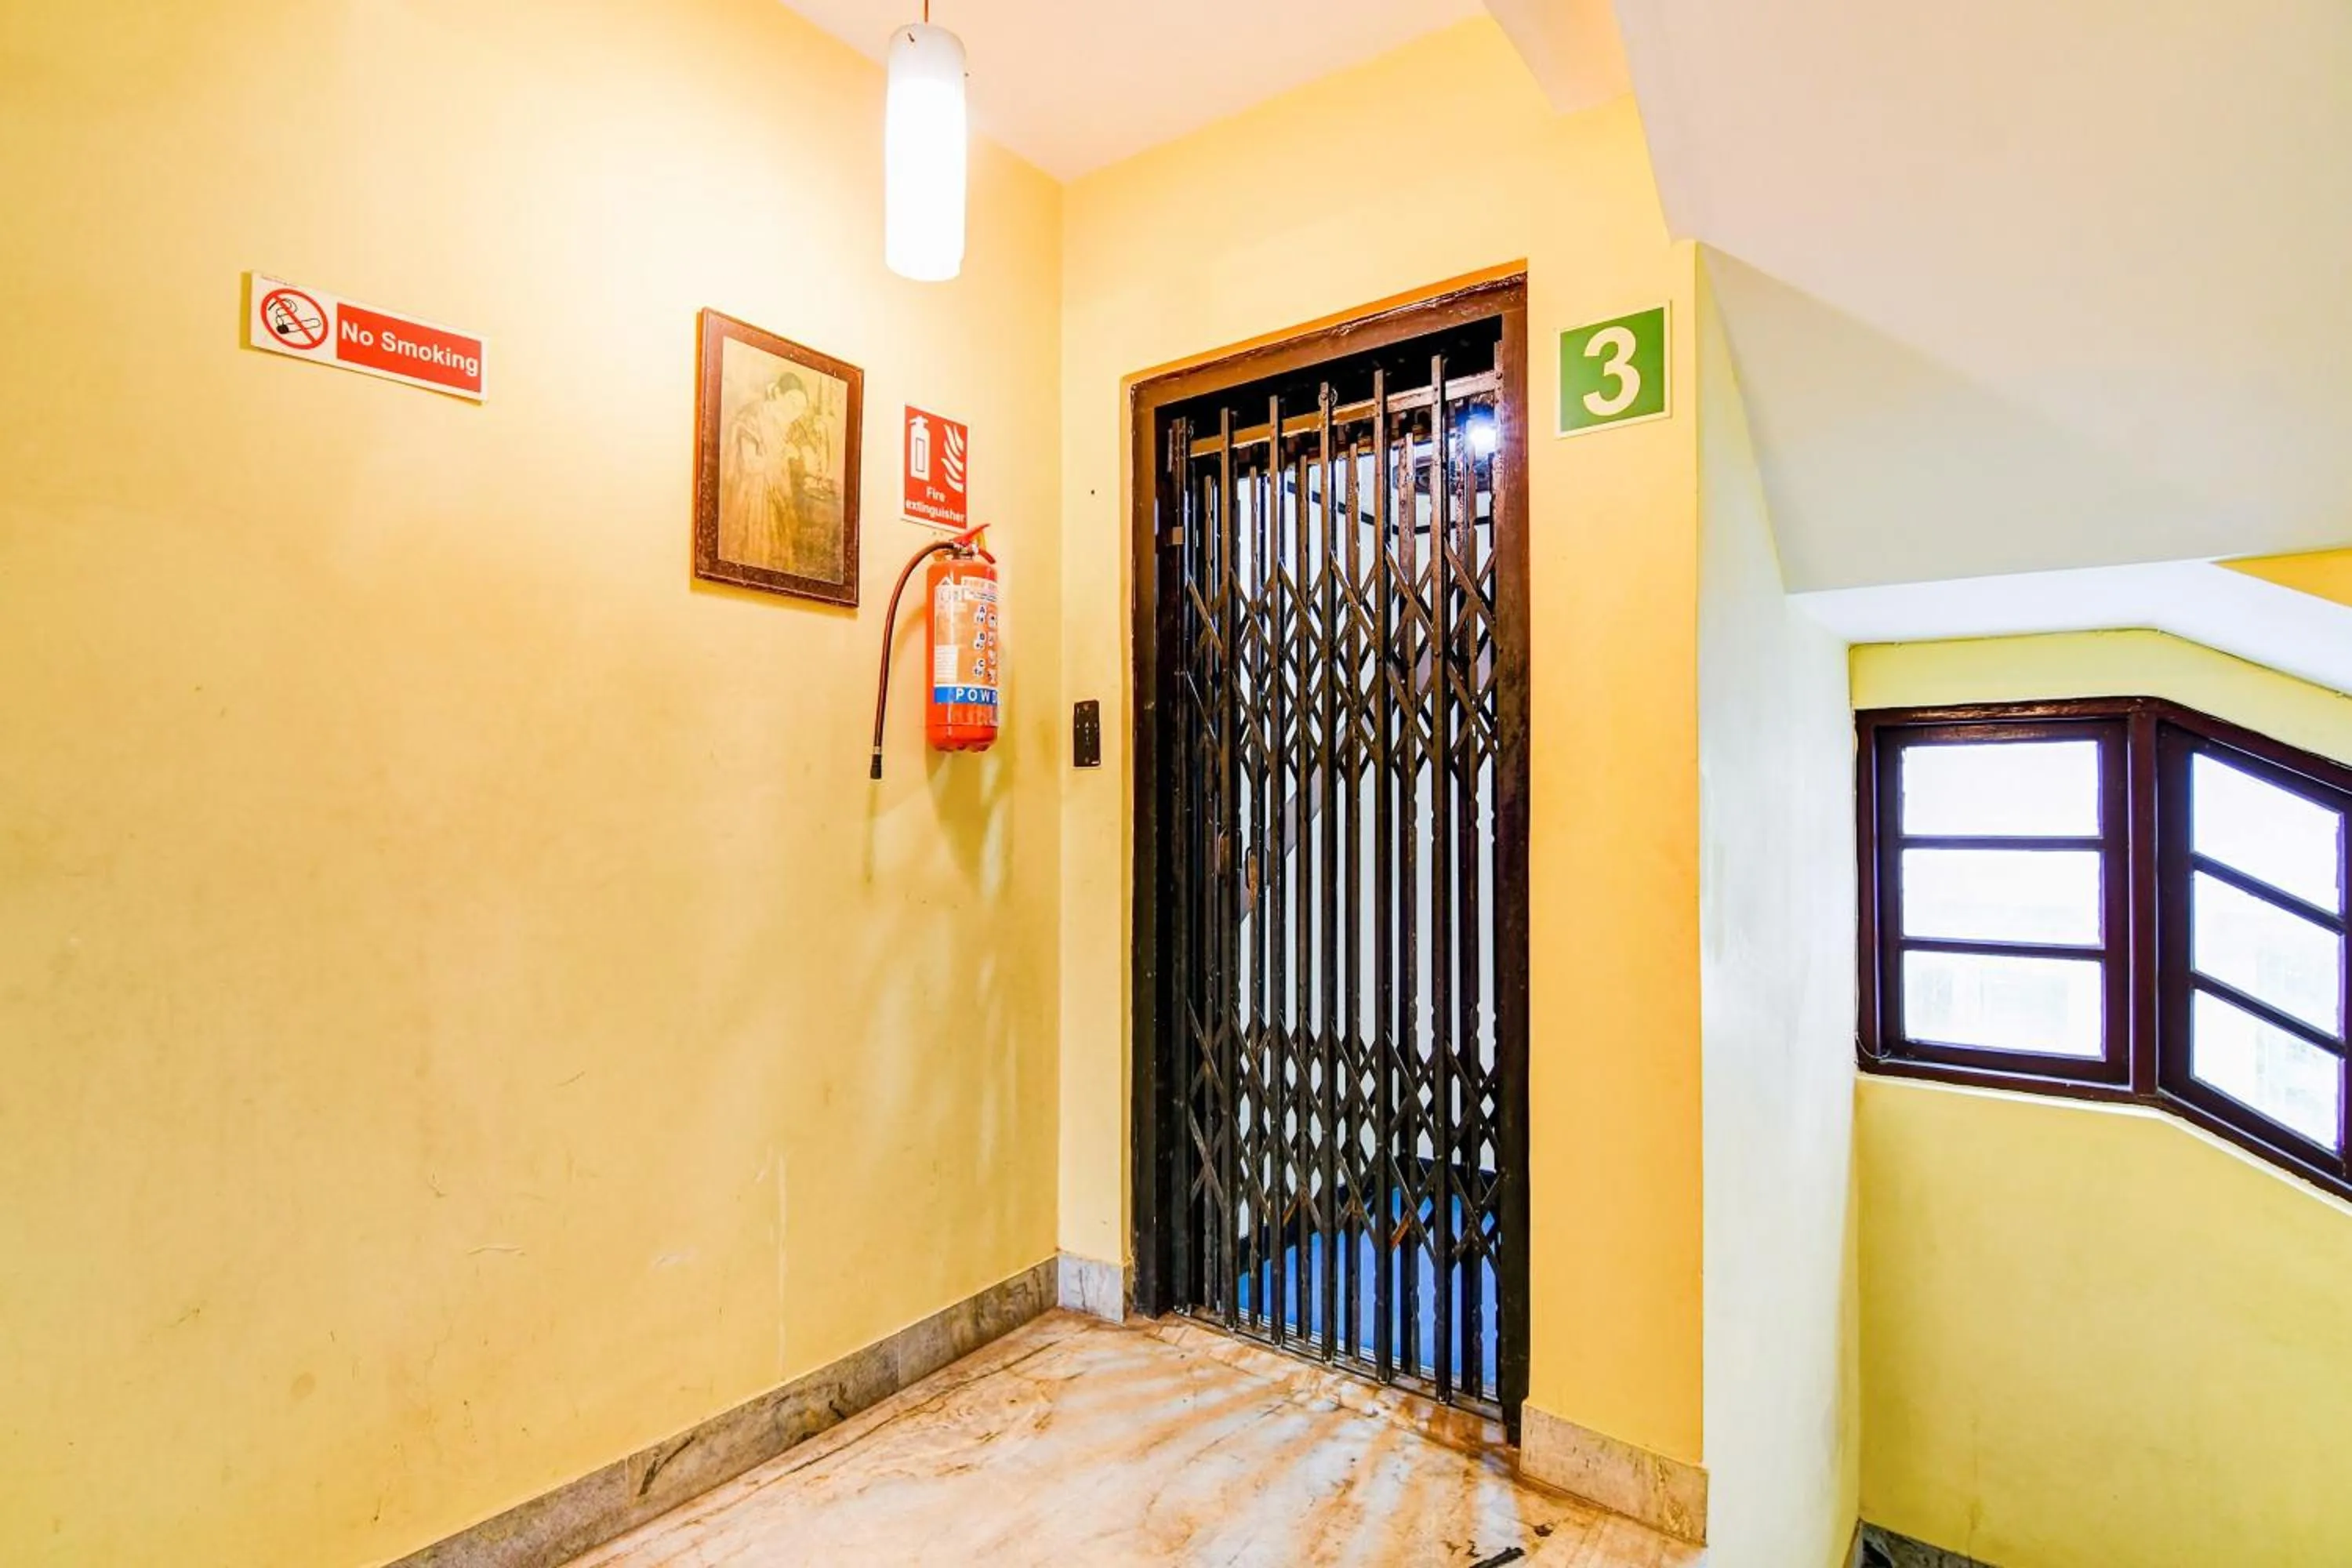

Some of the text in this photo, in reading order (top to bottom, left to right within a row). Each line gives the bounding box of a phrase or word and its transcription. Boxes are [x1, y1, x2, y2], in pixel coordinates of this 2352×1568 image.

[342, 320, 479, 377] No Smoking
[1583, 326, 1640, 416] 3
[906, 499, 967, 522] extinguisher
[926, 486, 946, 502] Fire
